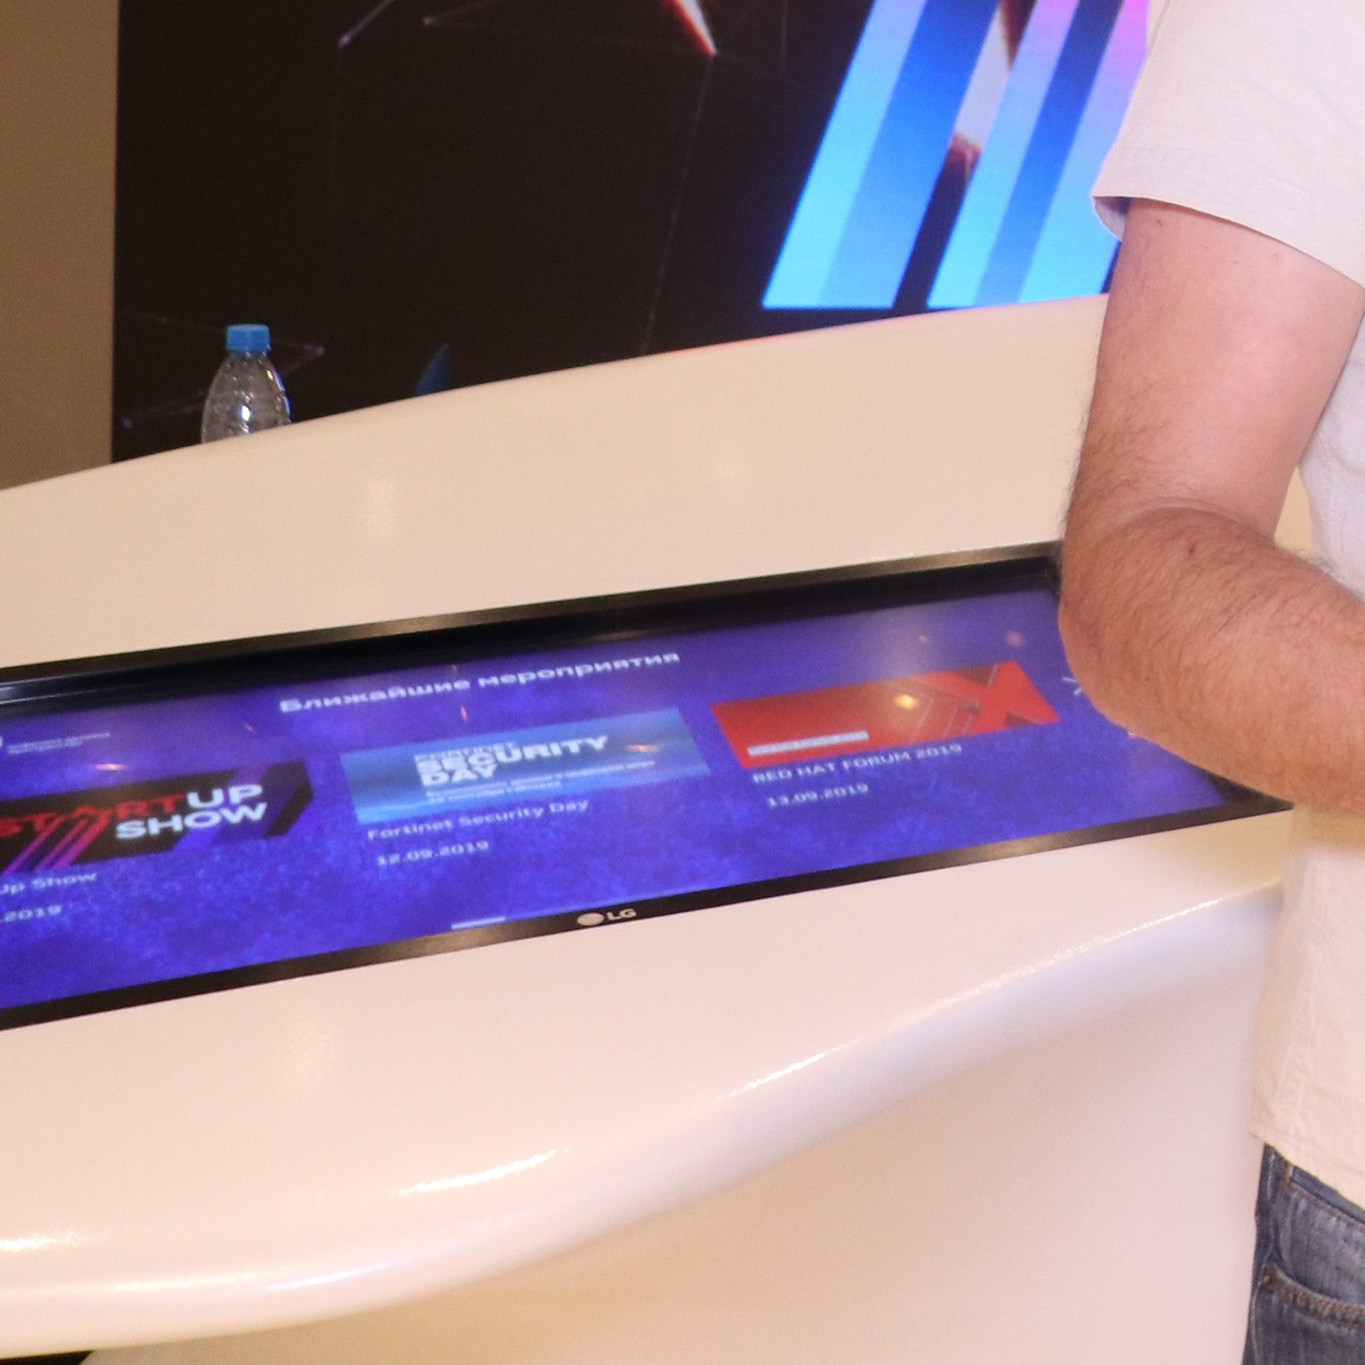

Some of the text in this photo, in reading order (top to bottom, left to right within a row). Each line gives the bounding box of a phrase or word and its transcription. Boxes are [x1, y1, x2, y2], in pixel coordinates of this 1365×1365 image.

[279, 652, 680, 713] Ближайшие мероприятия
[416, 735, 609, 773] SECURITY
[752, 743, 963, 784] RED HAT FORUM 2019
[421, 764, 498, 787] DAY
[767, 783, 870, 809] 13.09.2019
[115, 802, 268, 840] SHOW
[367, 800, 589, 841] Fortinet Security Day
[377, 839, 490, 866] 12.09.2019
[31, 872, 97, 889] Show
